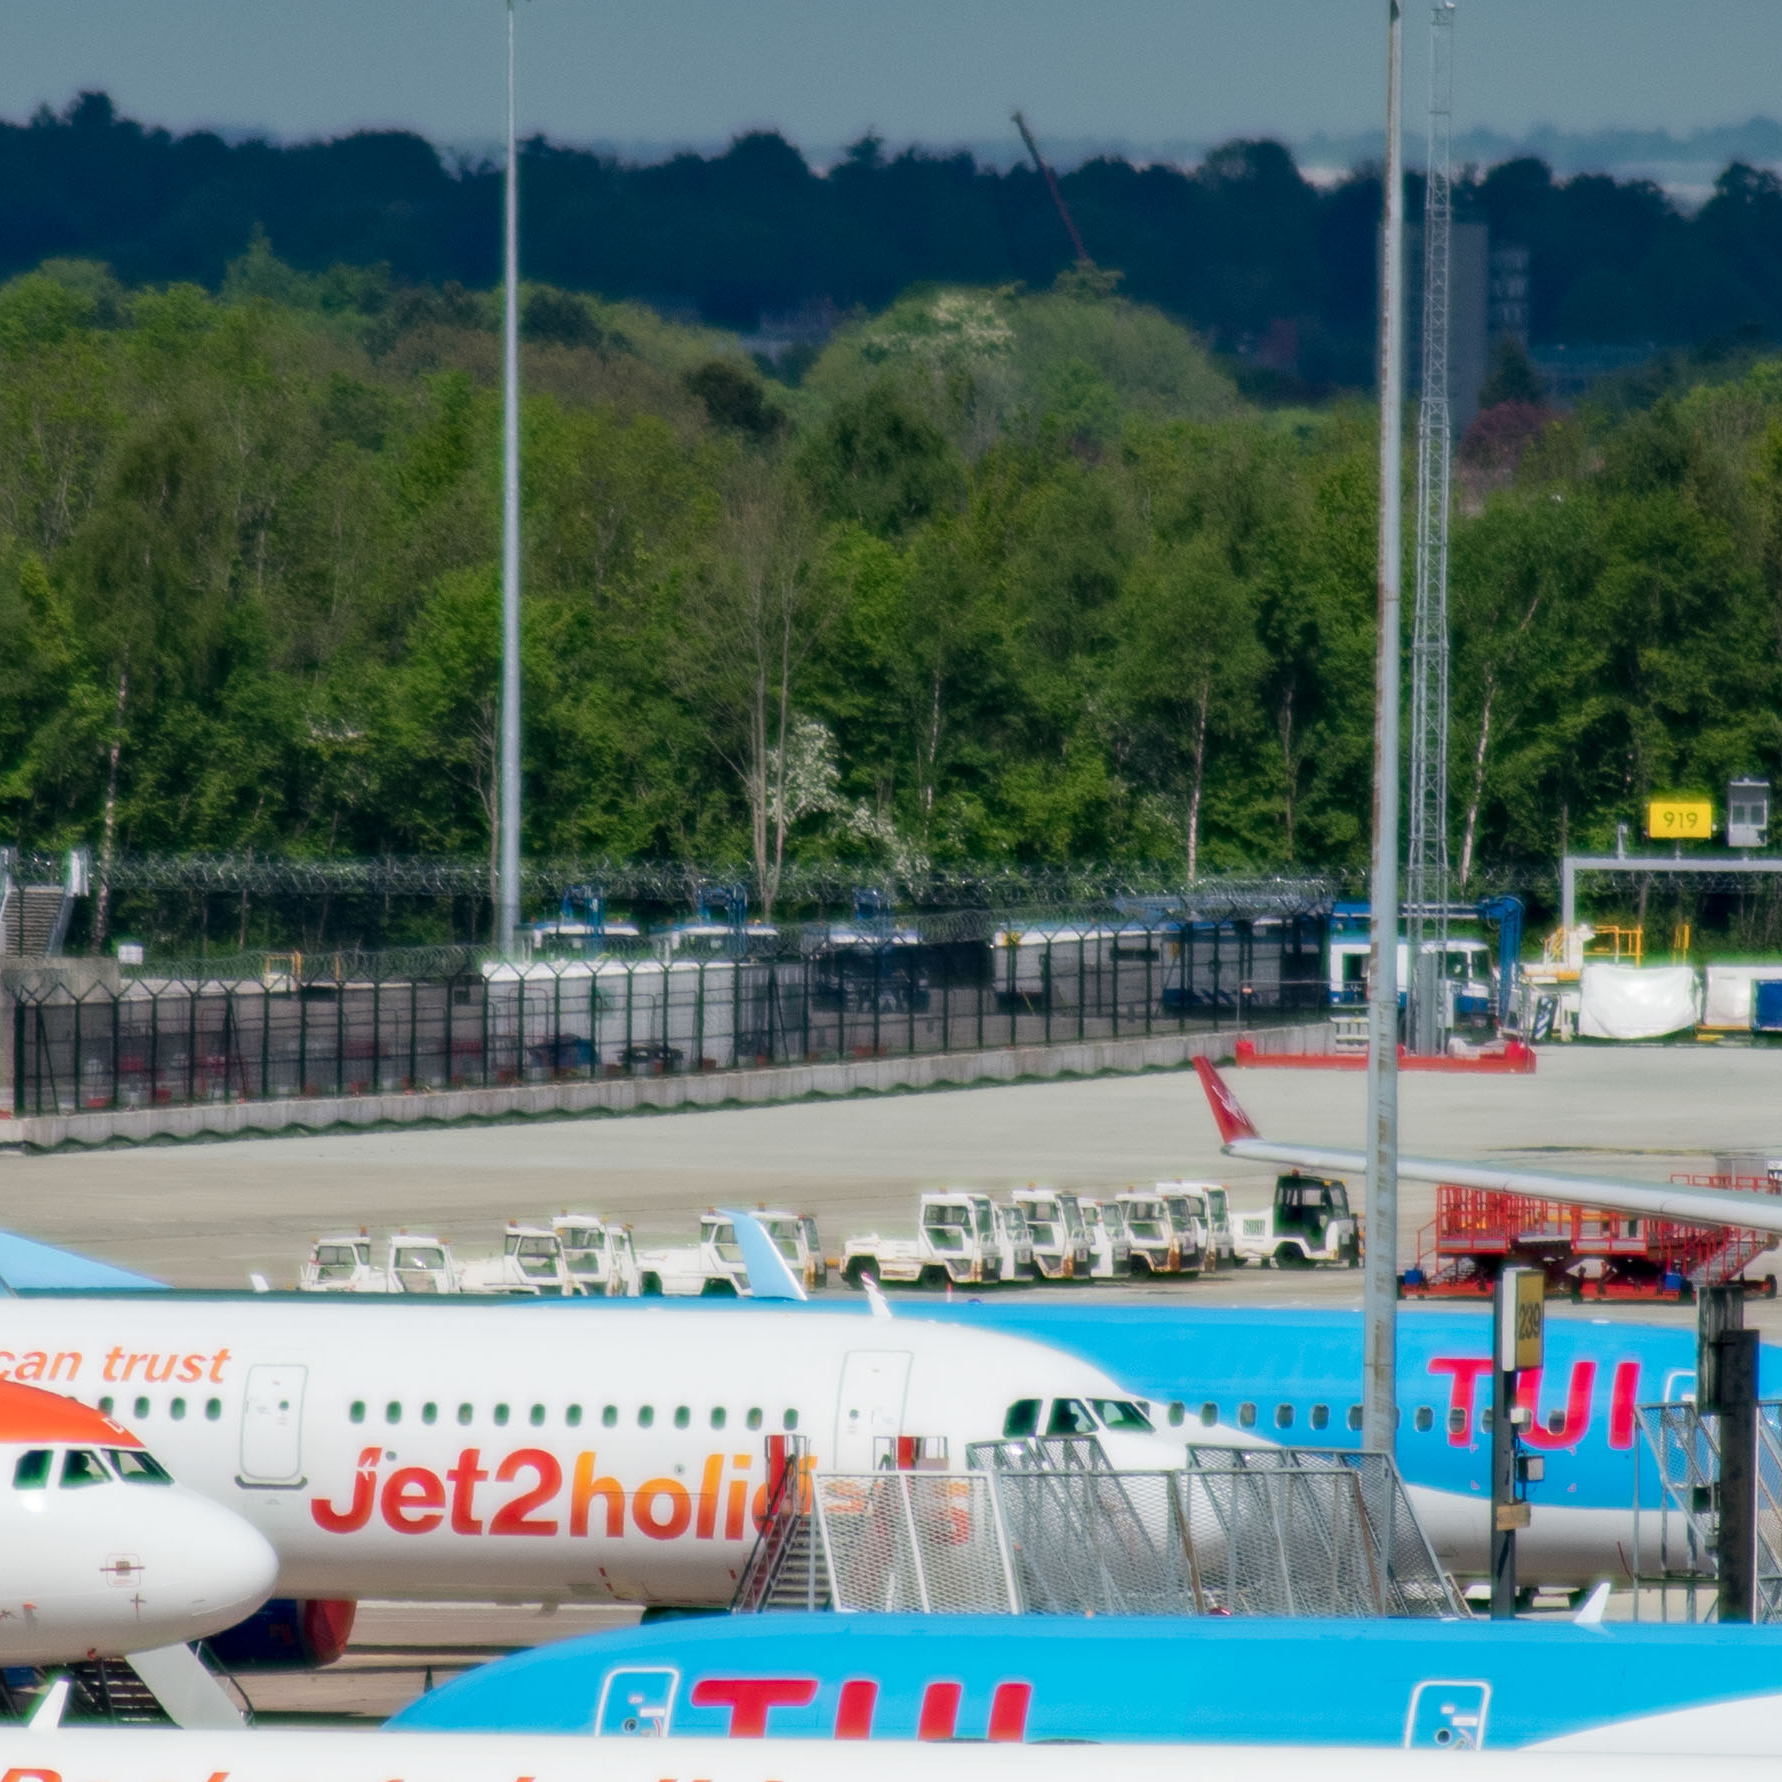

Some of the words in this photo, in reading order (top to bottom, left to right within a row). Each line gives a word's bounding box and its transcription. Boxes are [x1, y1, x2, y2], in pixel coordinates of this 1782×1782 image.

[1662, 810, 1699, 830] 919
[1518, 1303, 1541, 1341] 239
[102, 1346, 232, 1383] trust
[1426, 1357, 1641, 1451] TUI
